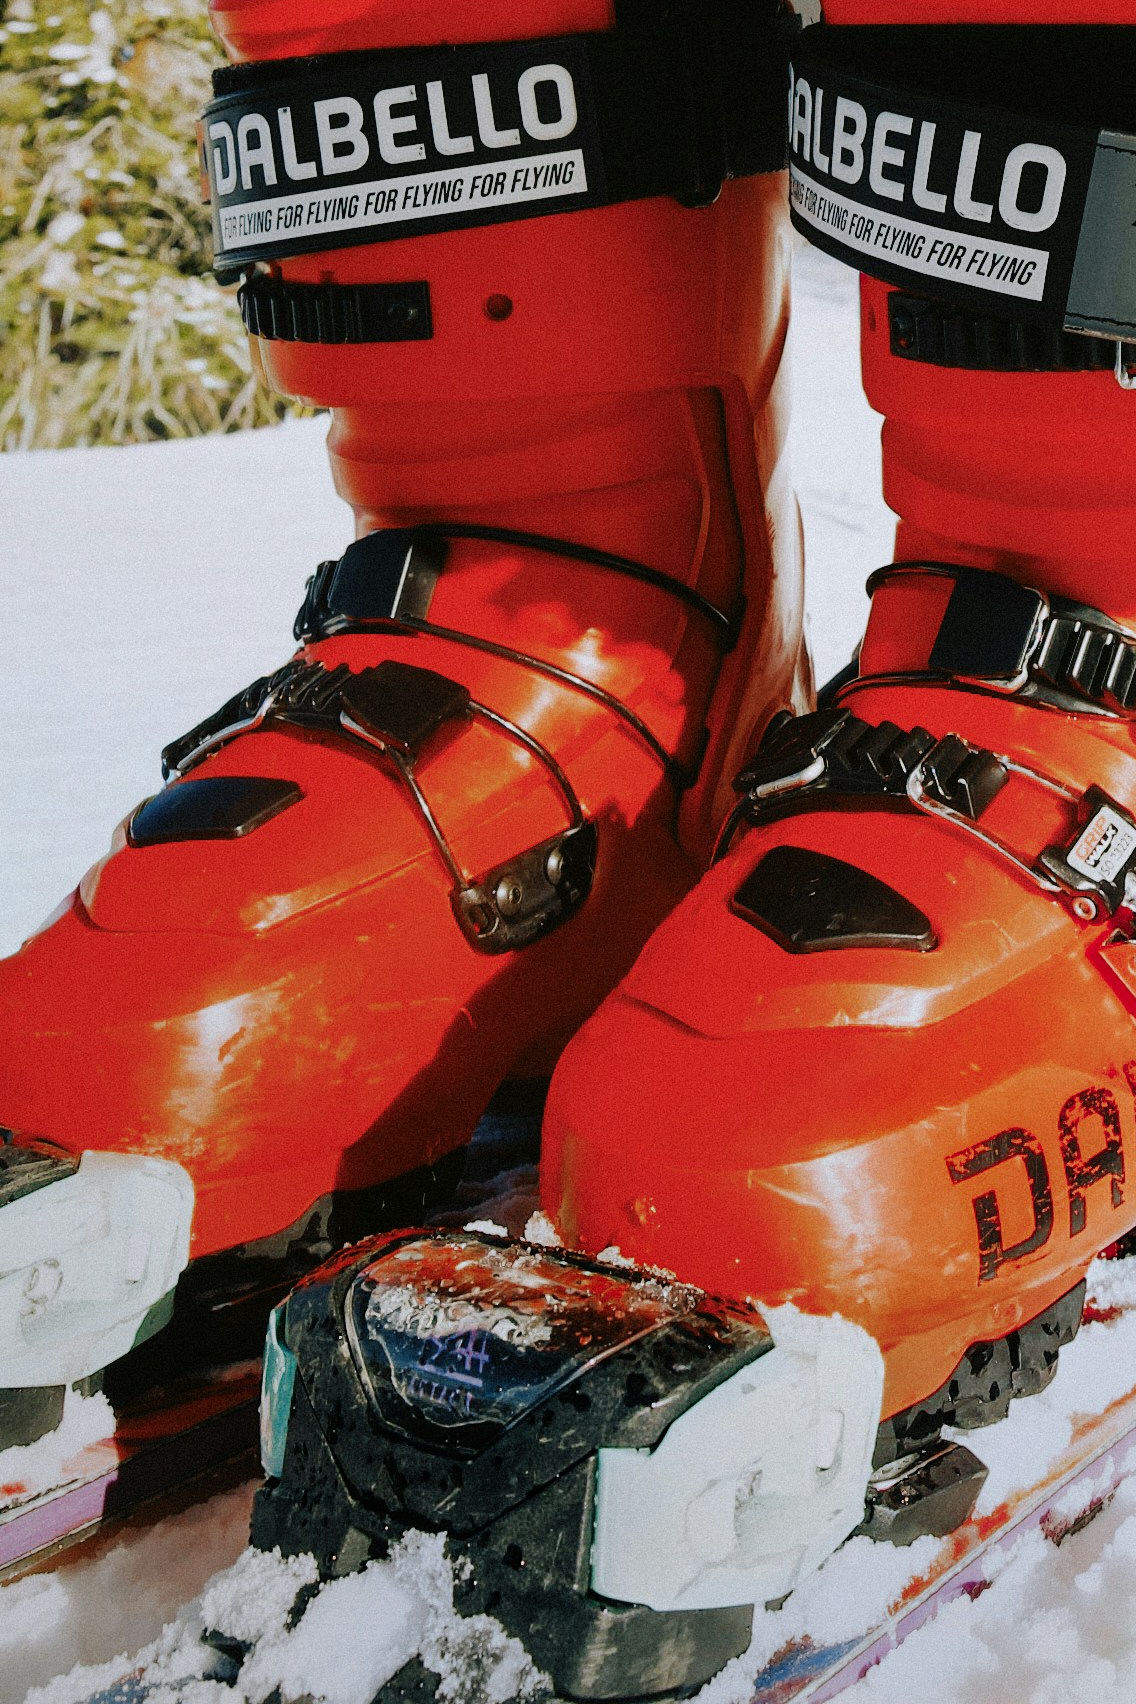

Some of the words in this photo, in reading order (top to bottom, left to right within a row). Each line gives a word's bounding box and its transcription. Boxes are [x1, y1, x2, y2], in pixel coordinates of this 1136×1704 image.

[209, 63, 578, 196] DALBELLO
[788, 61, 1067, 233] ALBELLO
[239, 208, 272, 237] FLYING
[276, 205, 304, 230] FOR
[306, 194, 359, 226] FLYING
[363, 188, 399, 216] FOR
[402, 178, 464, 210] FLYING
[469, 171, 507, 200] FOR
[511, 160, 575, 193] FLYING
[804, 186, 818, 216] FOR
[816, 196, 849, 232] FLYING
[848, 213, 875, 244] FOR
[874, 222, 926, 260] FLYING
[926, 239, 967, 270] FOR
[966, 249, 1037, 286] FLYING
[1075, 815, 1107, 862] GRIP
[1085, 823, 1117, 867] WALK
